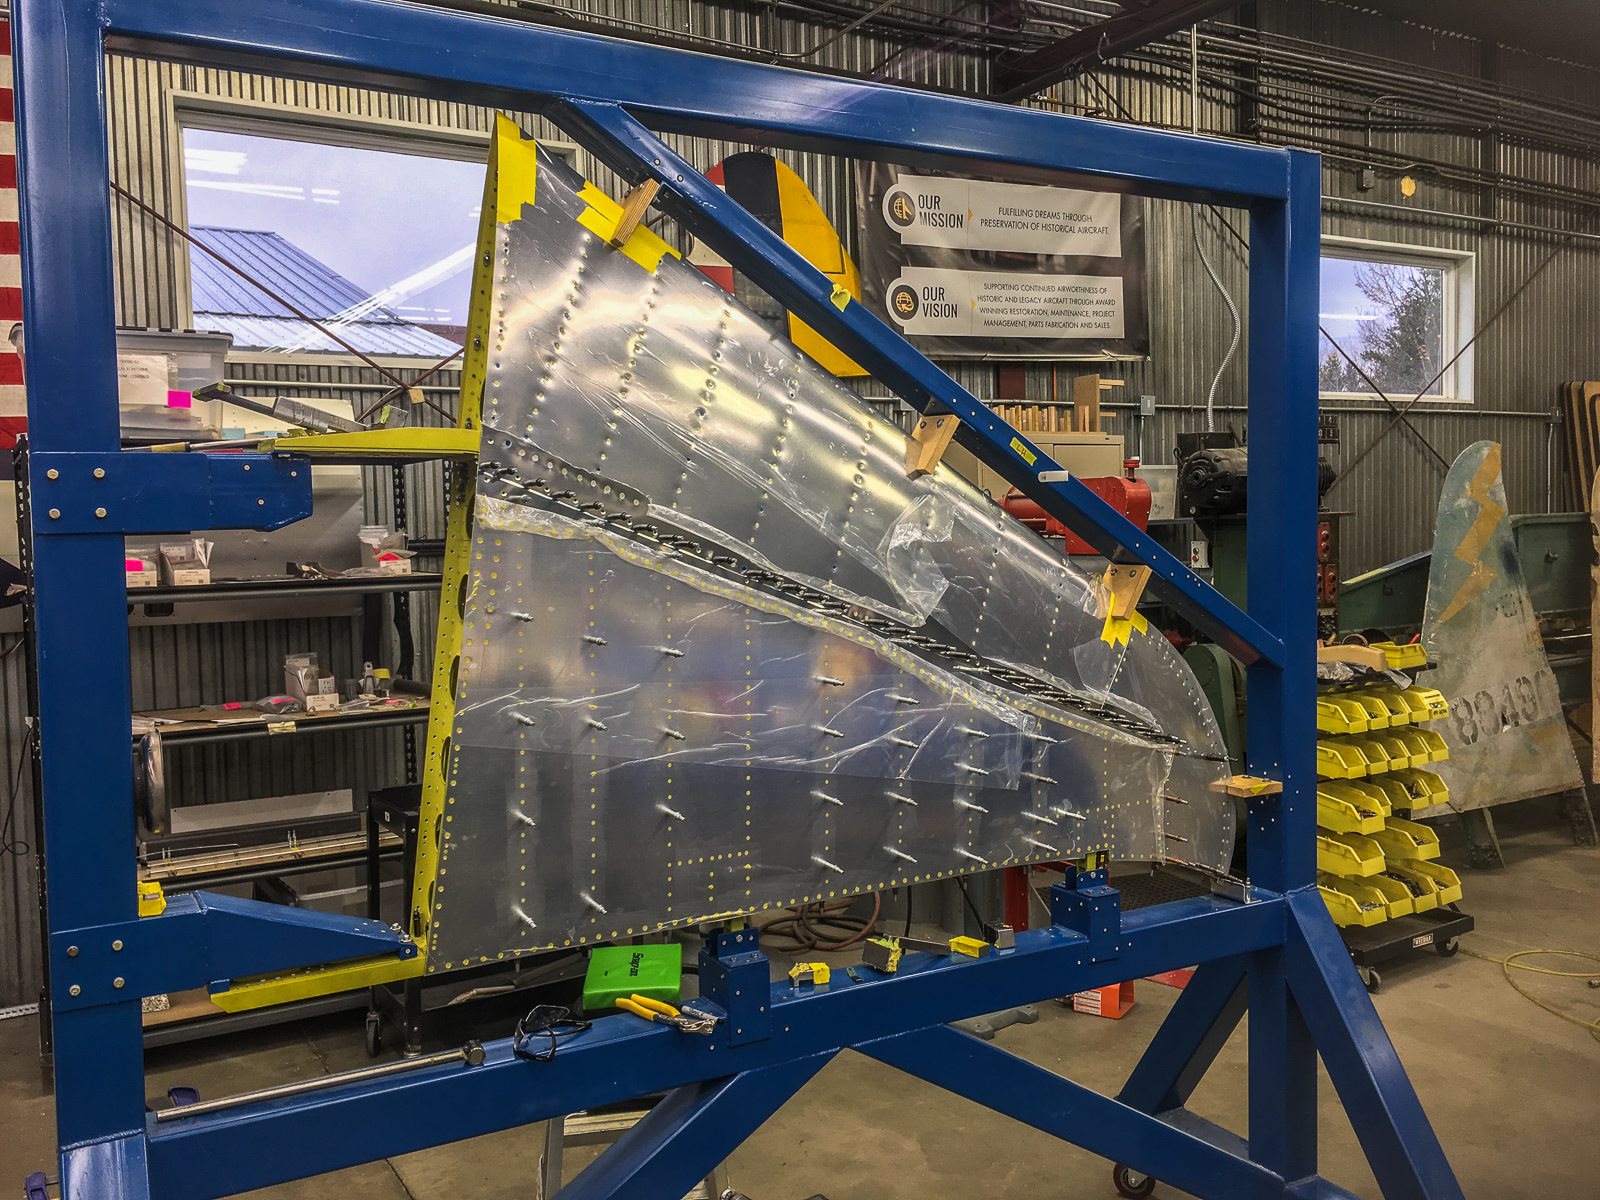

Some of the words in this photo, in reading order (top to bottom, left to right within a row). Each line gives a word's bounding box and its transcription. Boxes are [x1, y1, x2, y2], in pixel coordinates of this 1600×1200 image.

[918, 195, 940, 210] OUR
[919, 211, 963, 228] MISSION
[998, 207, 1033, 217] FULFILLING
[1034, 210, 1060, 220] DREAMS
[1062, 212, 1092, 222] THROUGH
[980, 218, 1028, 229] PRESERVATION
[1030, 222, 1039, 230] OF
[1042, 223, 1075, 233] HISTORICAL
[1077, 226, 1109, 234] AIRCRAFT.
[923, 286, 945, 301] OUR
[984, 283, 1019, 291] SUPPORTING
[1057, 286, 1098, 294] AIRWORTHINESS
[922, 303, 957, 318] VISION
[1010, 308, 1049, 316] RESTORATION,
[984, 320, 1027, 328] MANAGEMENT,
[1016, 443, 1026, 457] LH
[629, 952, 644, 977] Snap-on
